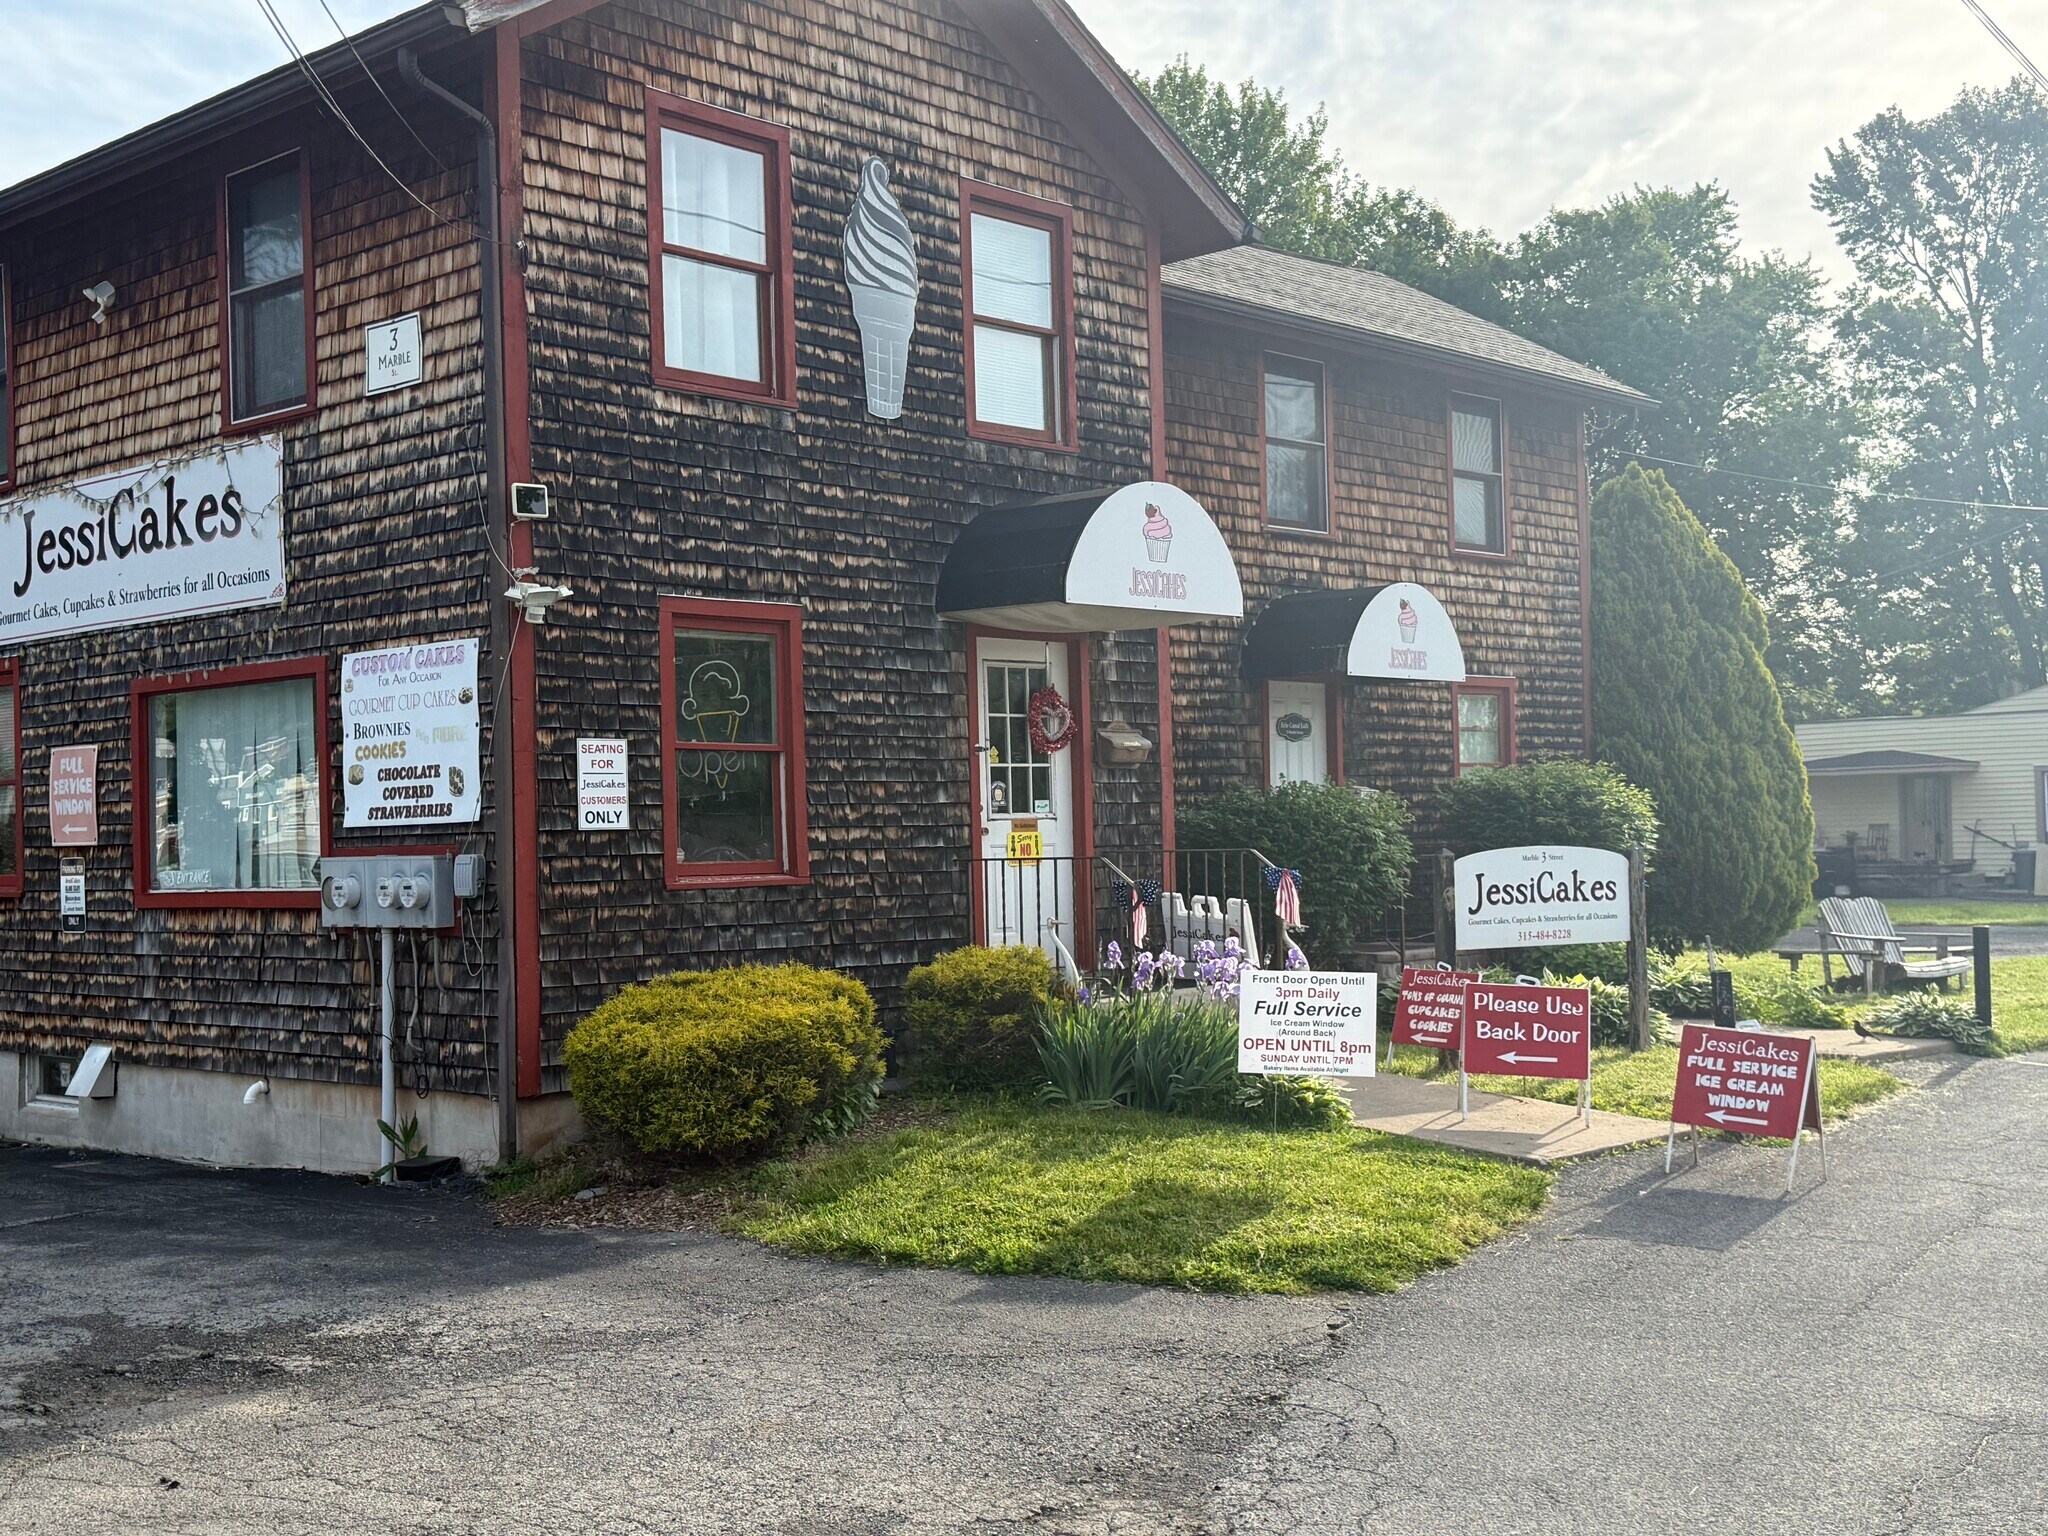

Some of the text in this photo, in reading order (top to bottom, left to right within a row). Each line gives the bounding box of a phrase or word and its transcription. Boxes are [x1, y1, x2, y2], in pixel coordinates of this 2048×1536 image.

[389, 327, 399, 351] 3
[378, 351, 411, 370] MARBLE
[14, 476, 242, 597] JessiCakes
[33, 602, 61, 620] Cakes,
[63, 593, 105, 618] Cupcakes
[108, 590, 116, 607] &
[119, 581, 180, 605] Strawberries
[184, 579, 199, 595] for
[202, 572, 214, 592] all
[218, 567, 270, 589] Occasions
[352, 645, 465, 676] CUSTOM CAKES
[349, 689, 458, 716] GOURMET CUP CAKES
[353, 722, 411, 740] BROWNIES
[355, 740, 407, 762] COOKIES
[581, 744, 624, 754] SEATING
[60, 757, 84, 774] FULL
[591, 759, 614, 769] FOR
[378, 764, 441, 782] CHOCOLATE
[53, 777, 93, 796] SERVICE
[382, 785, 434, 801] COVERED
[581, 779, 626, 791] JessiCakes
[54, 798, 93, 816] WINDOW
[581, 796, 627, 805] CUSTOMERS
[367, 803, 453, 820] STRAWBERRIES
[585, 810, 623, 824] ONLY
[1020, 843, 1032, 856] NO
[1541, 851, 1547, 864] 3
[1468, 869, 1617, 915] JessiCakes
[1468, 918, 1492, 926] Gourmet
[1493, 917, 1511, 925] Cakes,
[1512, 916, 1536, 926] Cupcakes
[1544, 914, 1576, 922] Strawberries
[1593, 912, 1618, 920] Occasions
[1518, 929, 1572, 941] 315-484-8228
[1252, 974, 1365, 986] Front Door Open Until
[1409, 970, 1465, 987] JessiCake
[1275, 987, 1340, 1002] 3pm Daily
[1402, 990, 1422, 1002] TONS
[1424, 992, 1436, 1002] OF
[1254, 1000, 1362, 1017] Full Service
[1408, 1004, 1460, 1019] CUPCAKES
[1474, 992, 1584, 1016] Please Use
[1270, 1019, 1345, 1028] Ice Cream Window
[1410, 1018, 1454, 1034] COOKIES
[1476, 1020, 1582, 1044] Back Door
[1278, 1028, 1336, 1038] (Around Back)
[1244, 1038, 1372, 1056] OPEN UNTIL 8pm
[1694, 1033, 1800, 1062] JessiCakes
[1260, 1054, 1354, 1065] SUNDAY UNTIL 7PM
[1686, 1055, 1798, 1079] FULL SERVICE
[1264, 1065, 1282, 1073] Bakery
[1695, 1073, 1784, 1096] ICE CREAM
[1708, 1092, 1770, 1112] WINDOW
